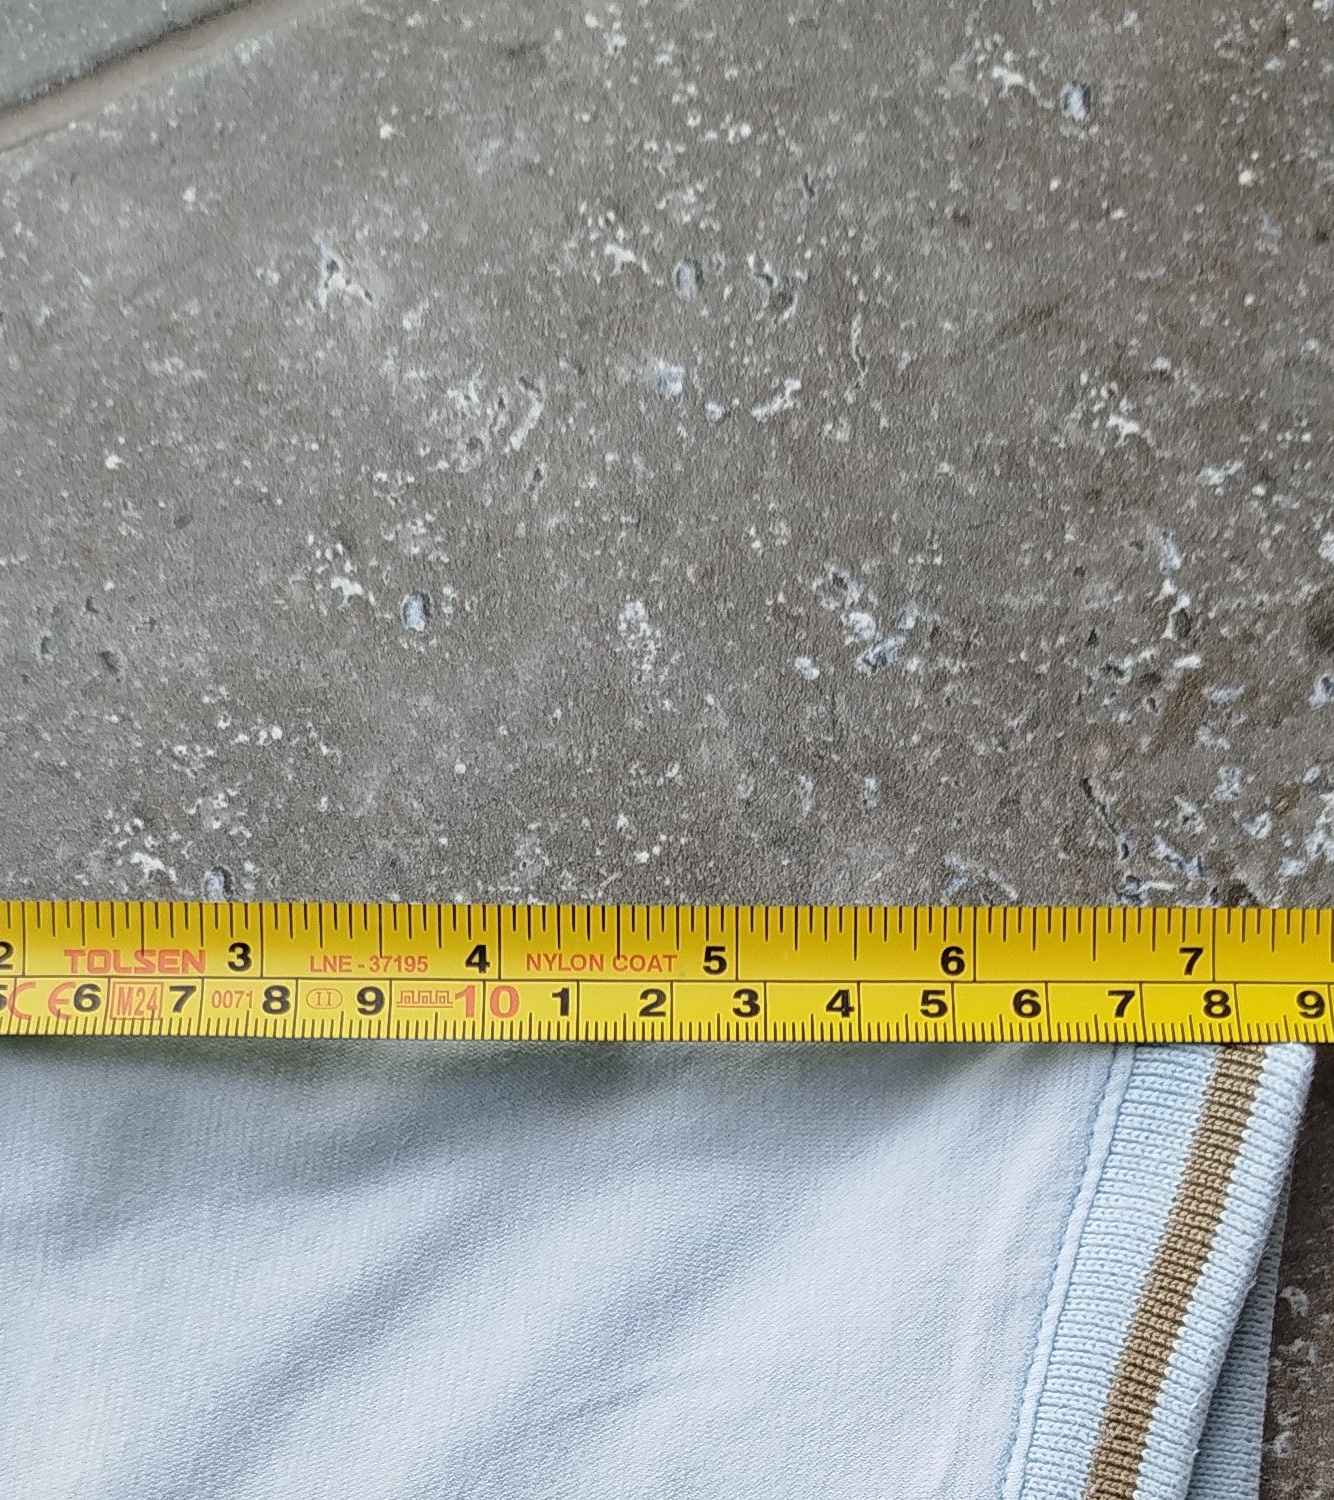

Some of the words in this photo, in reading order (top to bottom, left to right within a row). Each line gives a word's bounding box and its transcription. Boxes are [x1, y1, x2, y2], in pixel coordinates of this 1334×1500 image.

[63, 948, 206, 975] TOLSEN
[227, 942, 253, 973] 3
[310, 955, 352, 973] LNE
[369, 955, 429, 974] 37195
[464, 945, 491, 975] 4
[526, 953, 605, 973] NYLON
[612, 954, 677, 973] COAT
[703, 946, 727, 975] 5
[940, 946, 966, 976] 6
[1179, 947, 1205, 976] 7
[72, 984, 102, 1012] 6
[116, 986, 159, 1014] M24
[168, 985, 197, 1013] 7
[211, 989, 254, 1010] 0071
[261, 985, 292, 1014] 8
[356, 986, 386, 1015] 9
[456, 986, 519, 1019] 10
[552, 988, 571, 1016] 1
[639, 989, 668, 1017] 2
[731, 989, 760, 1017] 3
[825, 989, 855, 1018] 4
[919, 989, 948, 1018] 5
[1012, 990, 1042, 1018] 6
[1107, 990, 1136, 1018] 7
[1202, 990, 1232, 1018] 8
[1296, 990, 1326, 1019] 9
